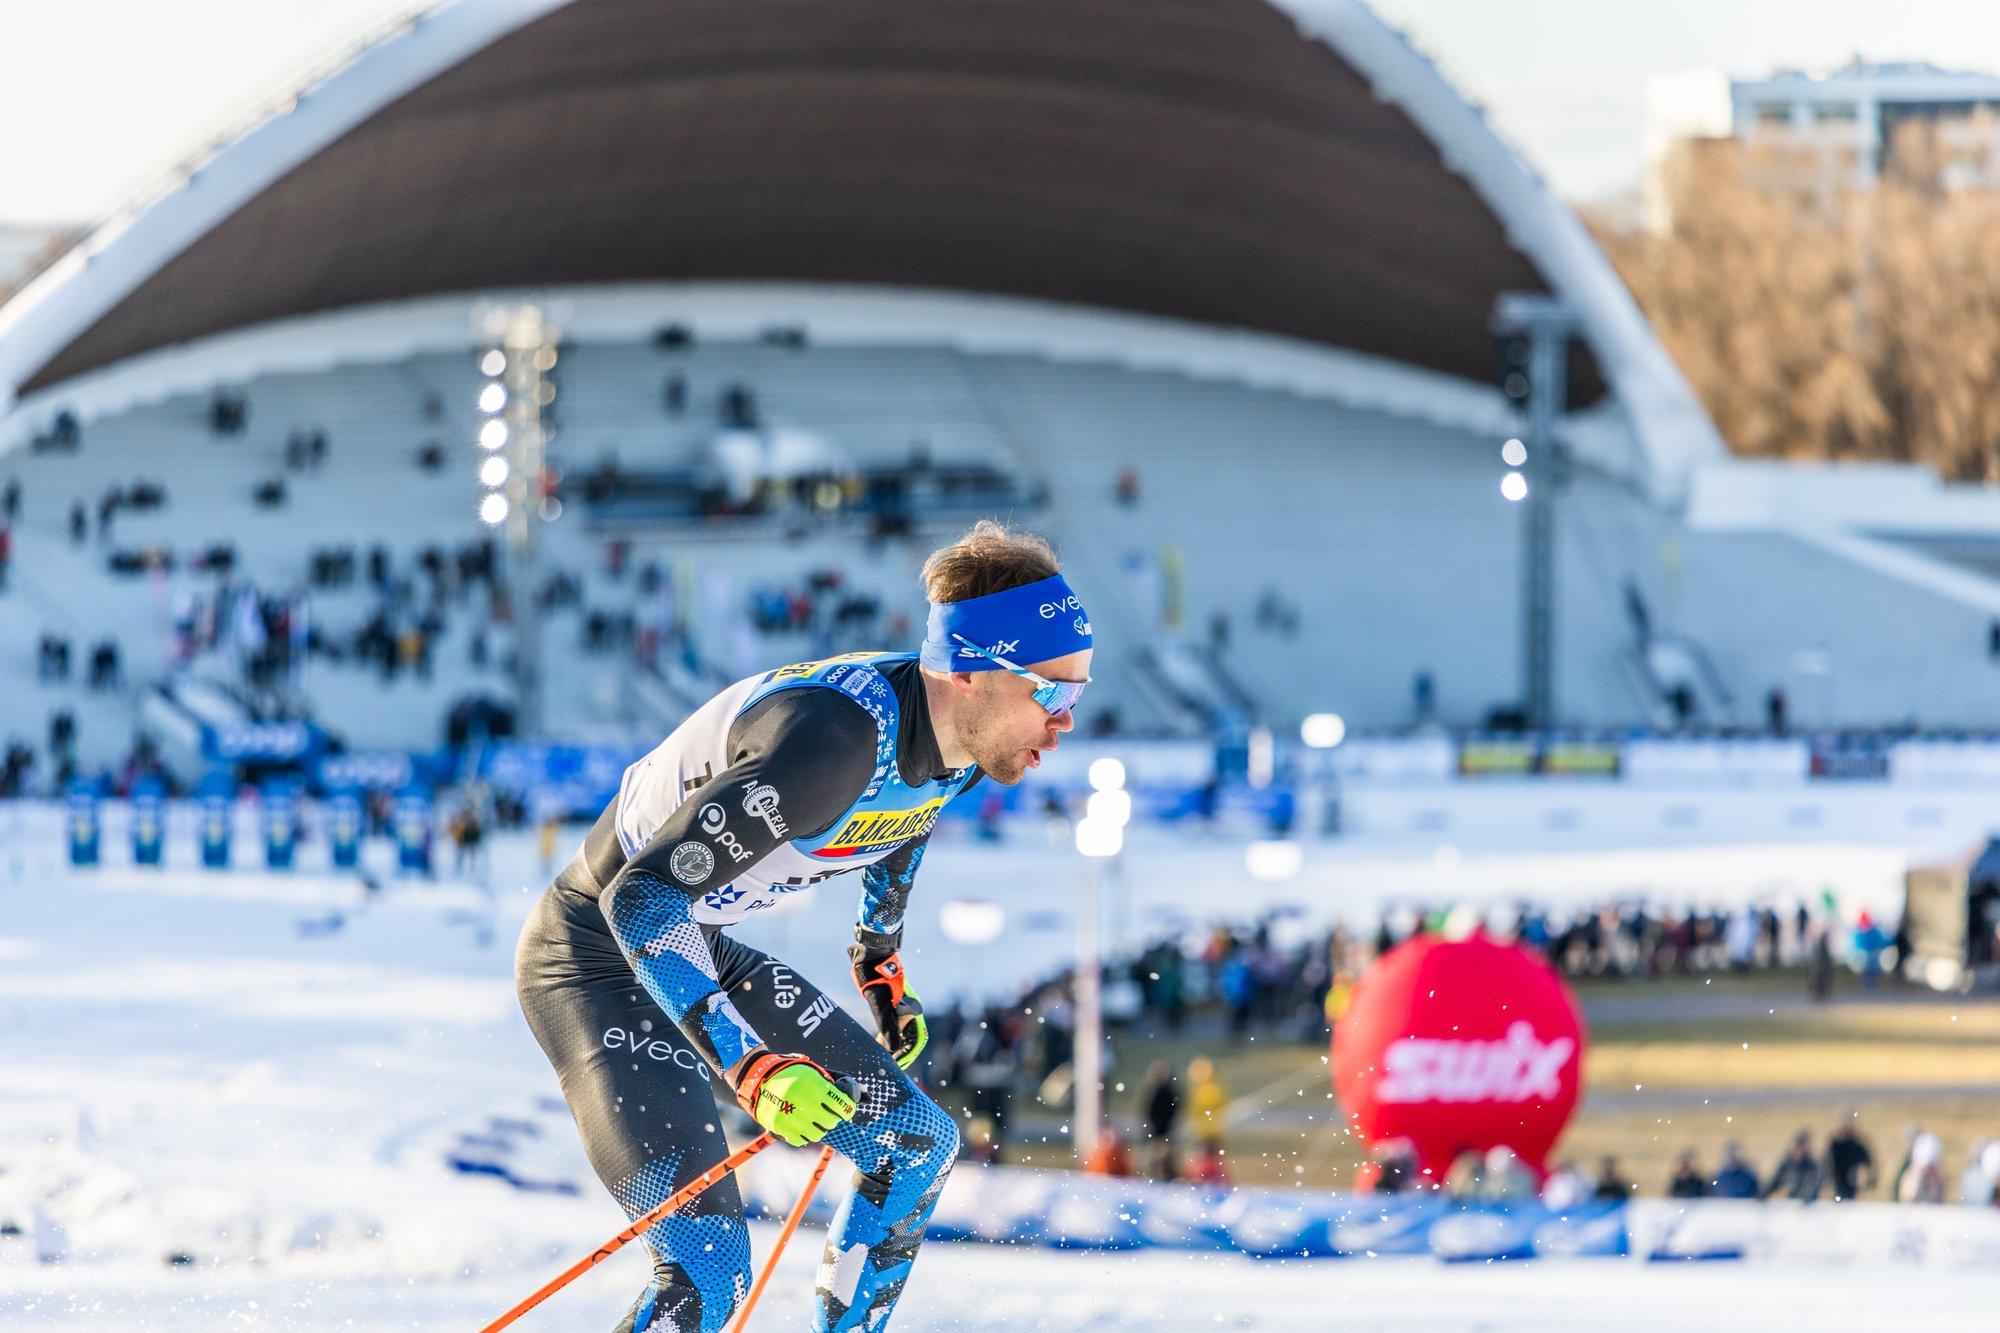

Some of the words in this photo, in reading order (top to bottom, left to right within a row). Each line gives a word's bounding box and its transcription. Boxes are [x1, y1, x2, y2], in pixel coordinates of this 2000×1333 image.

[1039, 596, 1083, 619] eve
[833, 806, 941, 846] BLÅKLÄDER
[714, 831, 754, 863] paf
[603, 1027, 711, 1082] eveco
[1376, 1020, 1574, 1104] swix
